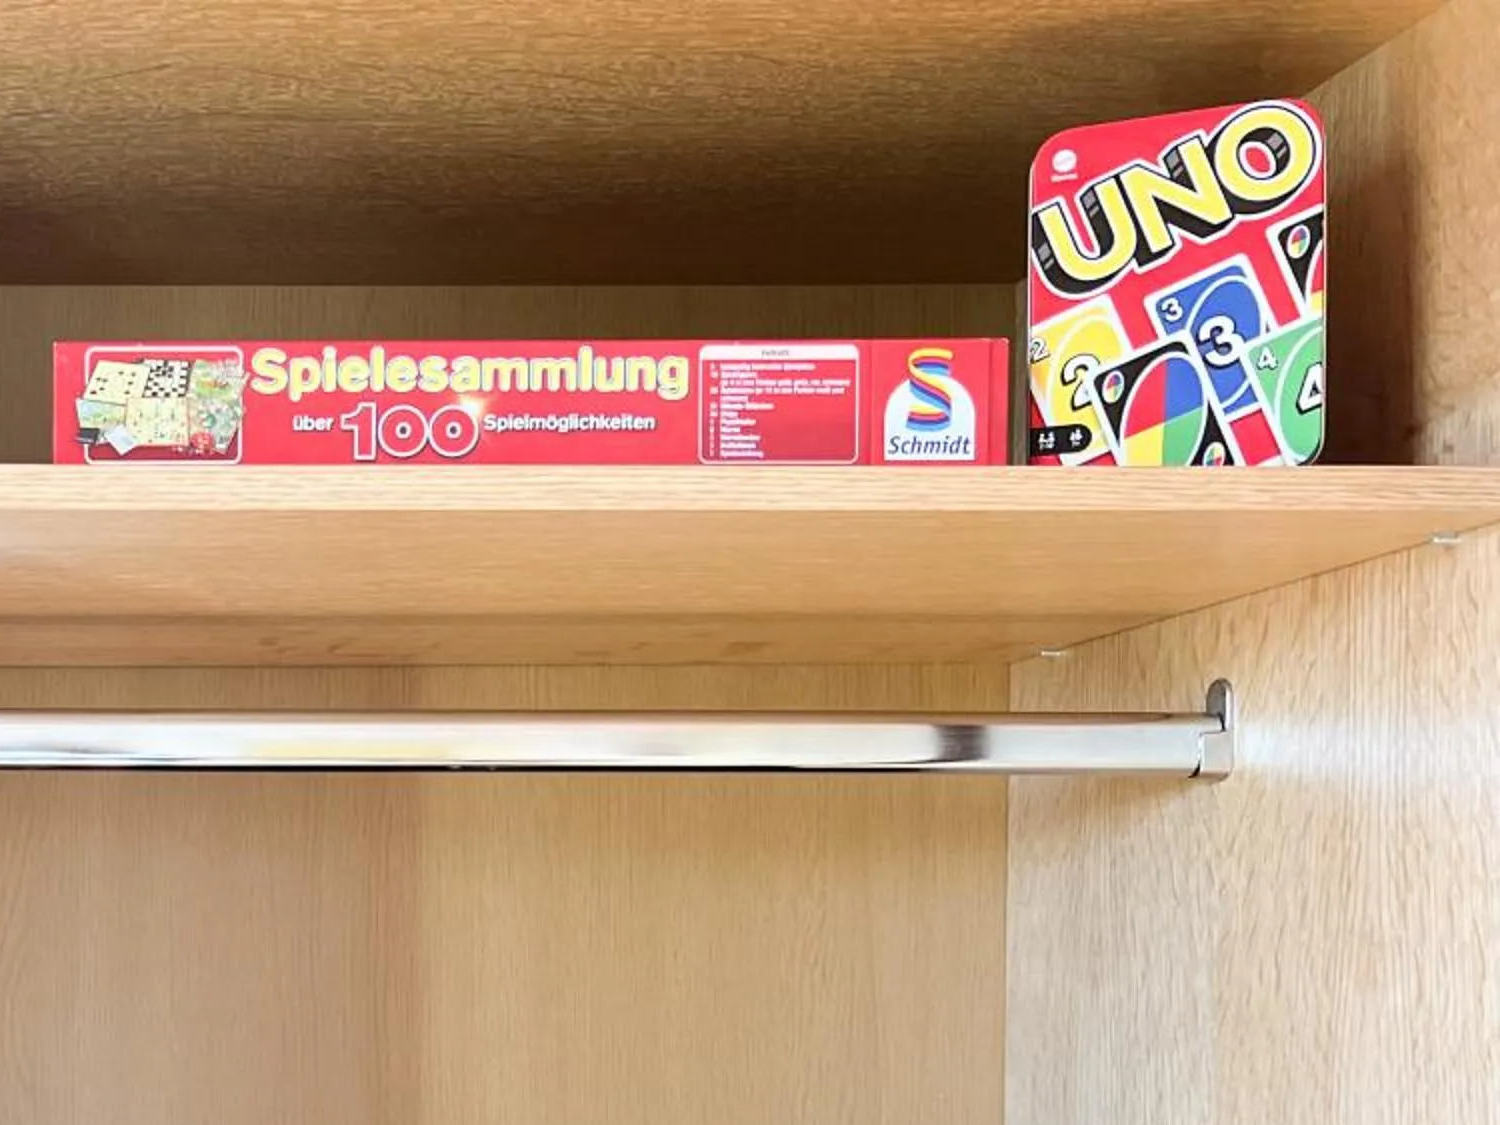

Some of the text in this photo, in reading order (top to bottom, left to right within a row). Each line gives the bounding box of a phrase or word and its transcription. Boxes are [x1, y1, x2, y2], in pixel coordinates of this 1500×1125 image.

[1032, 103, 1320, 296] UNO
[1160, 298, 1184, 324] 3
[1197, 314, 1245, 369] 3
[251, 345, 689, 402] Spielesammlung
[1060, 353, 1100, 411] 2
[292, 401, 656, 460] über 100 Spielmöglichkeiten
[887, 435, 972, 456] Schmidt
